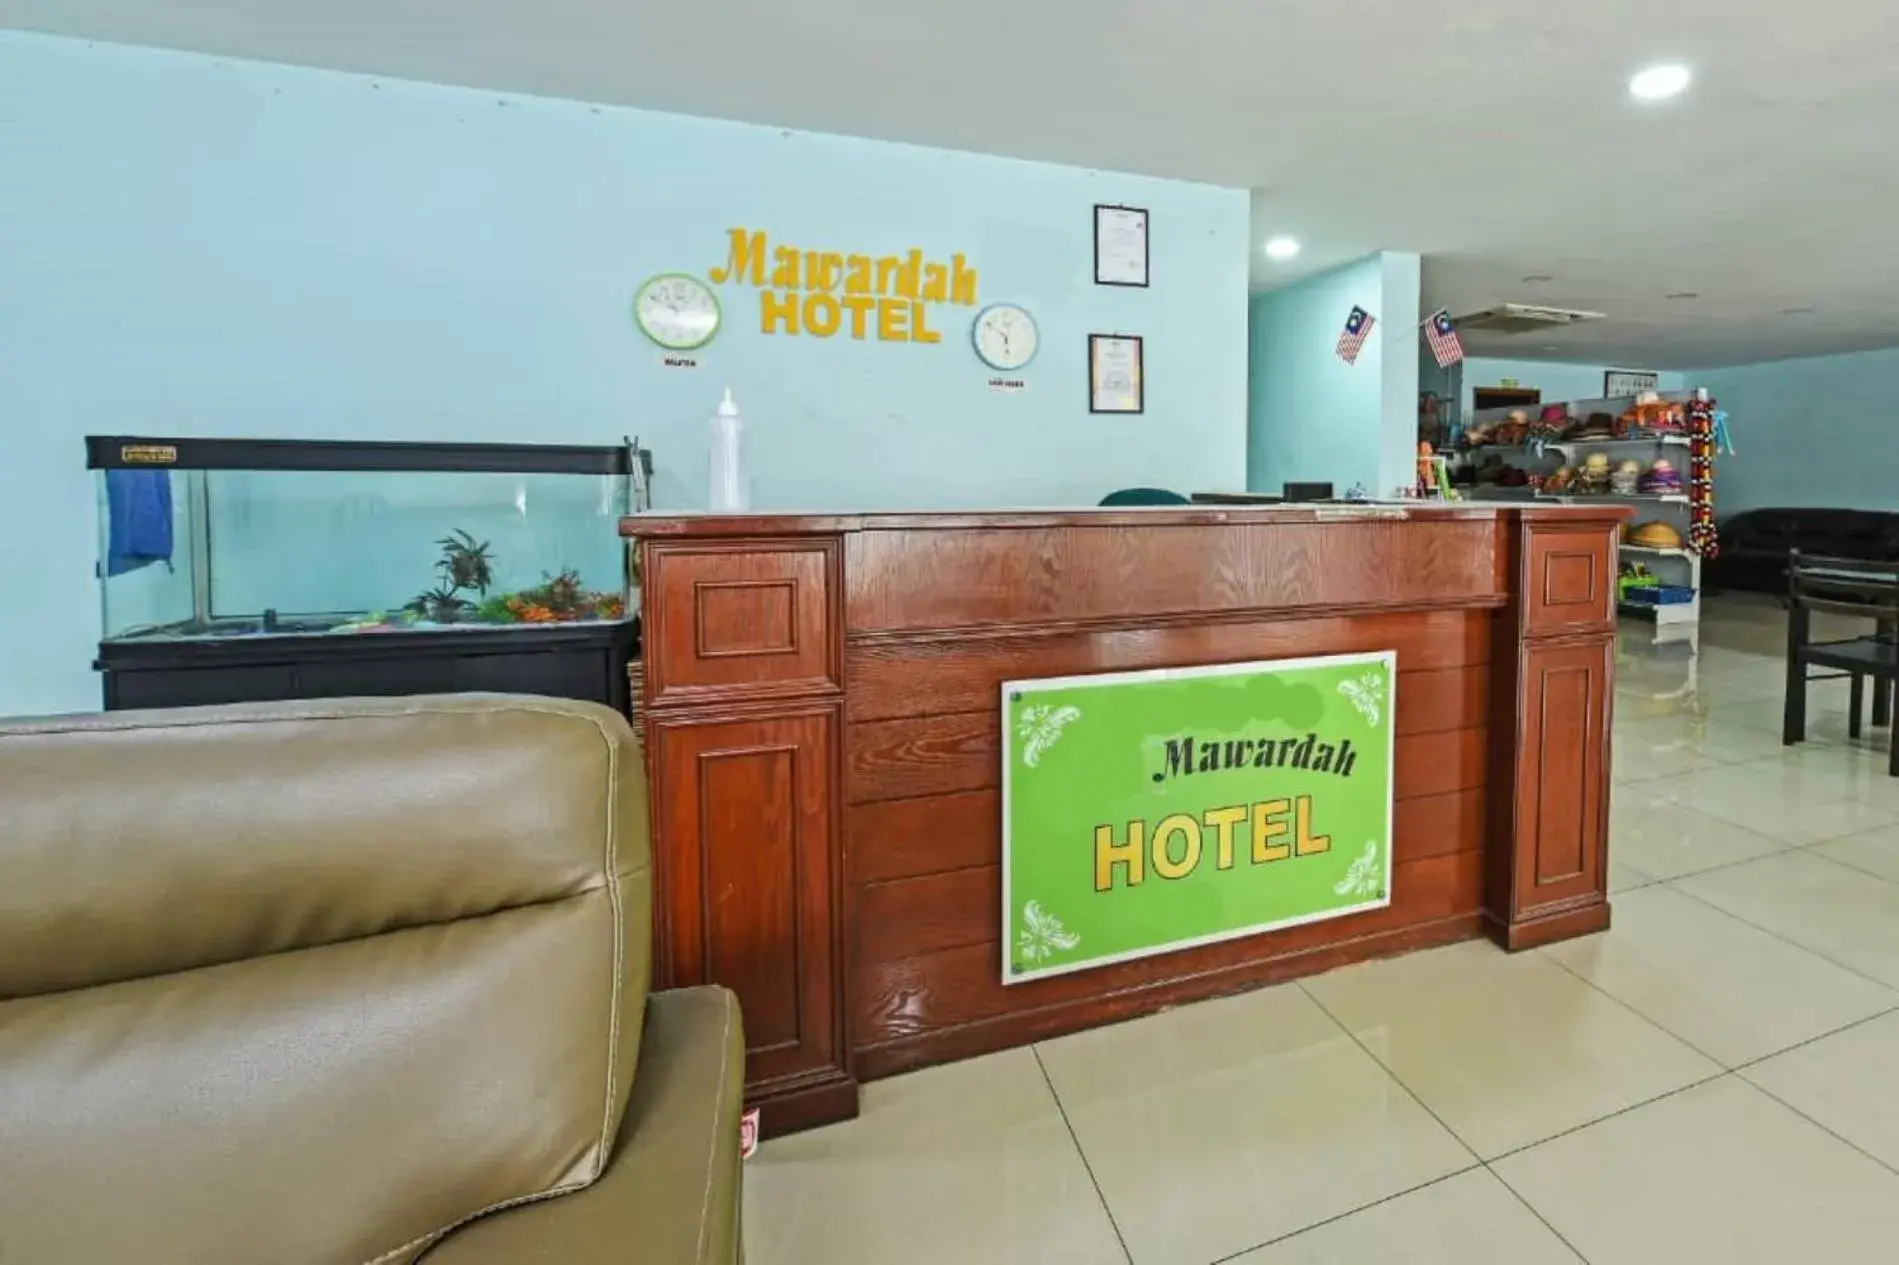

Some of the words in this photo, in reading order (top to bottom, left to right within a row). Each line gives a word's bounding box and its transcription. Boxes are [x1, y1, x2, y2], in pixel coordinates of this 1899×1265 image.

[709, 228, 977, 306] Mawardah
[760, 289, 941, 343] HOTEL
[1152, 733, 1357, 782] Mawardah
[1094, 794, 1332, 893] HOTEL
